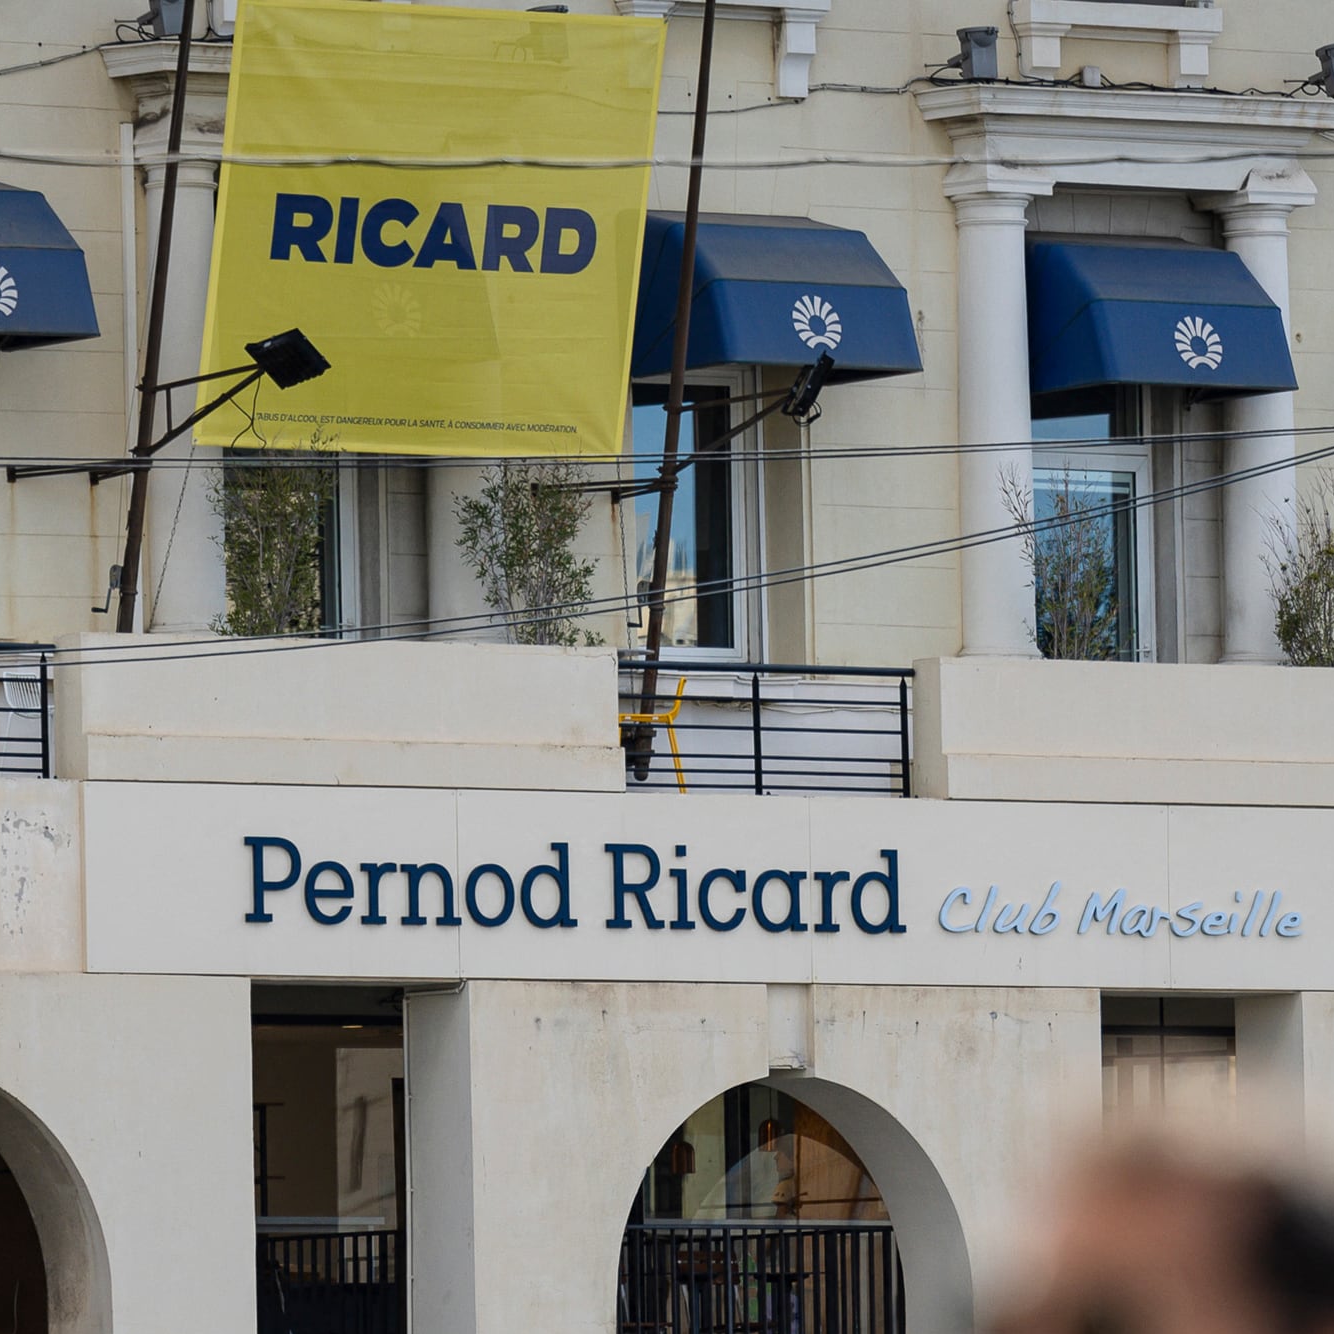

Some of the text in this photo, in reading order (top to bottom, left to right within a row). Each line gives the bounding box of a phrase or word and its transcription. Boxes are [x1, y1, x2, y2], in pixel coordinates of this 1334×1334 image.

[270, 193, 597, 275] RICARD
[280, 413, 317, 424] D'ALCOOL
[320, 415, 335, 425] EST
[336, 416, 383, 427] DANGEREUX
[384, 418, 407, 428] POUR
[407, 419, 418, 428] LA
[455, 421, 505, 432] CONSOMMER
[506, 423, 526, 432] AVEC
[244, 835, 1305, 941] Pernod Ricard Club Marseille
